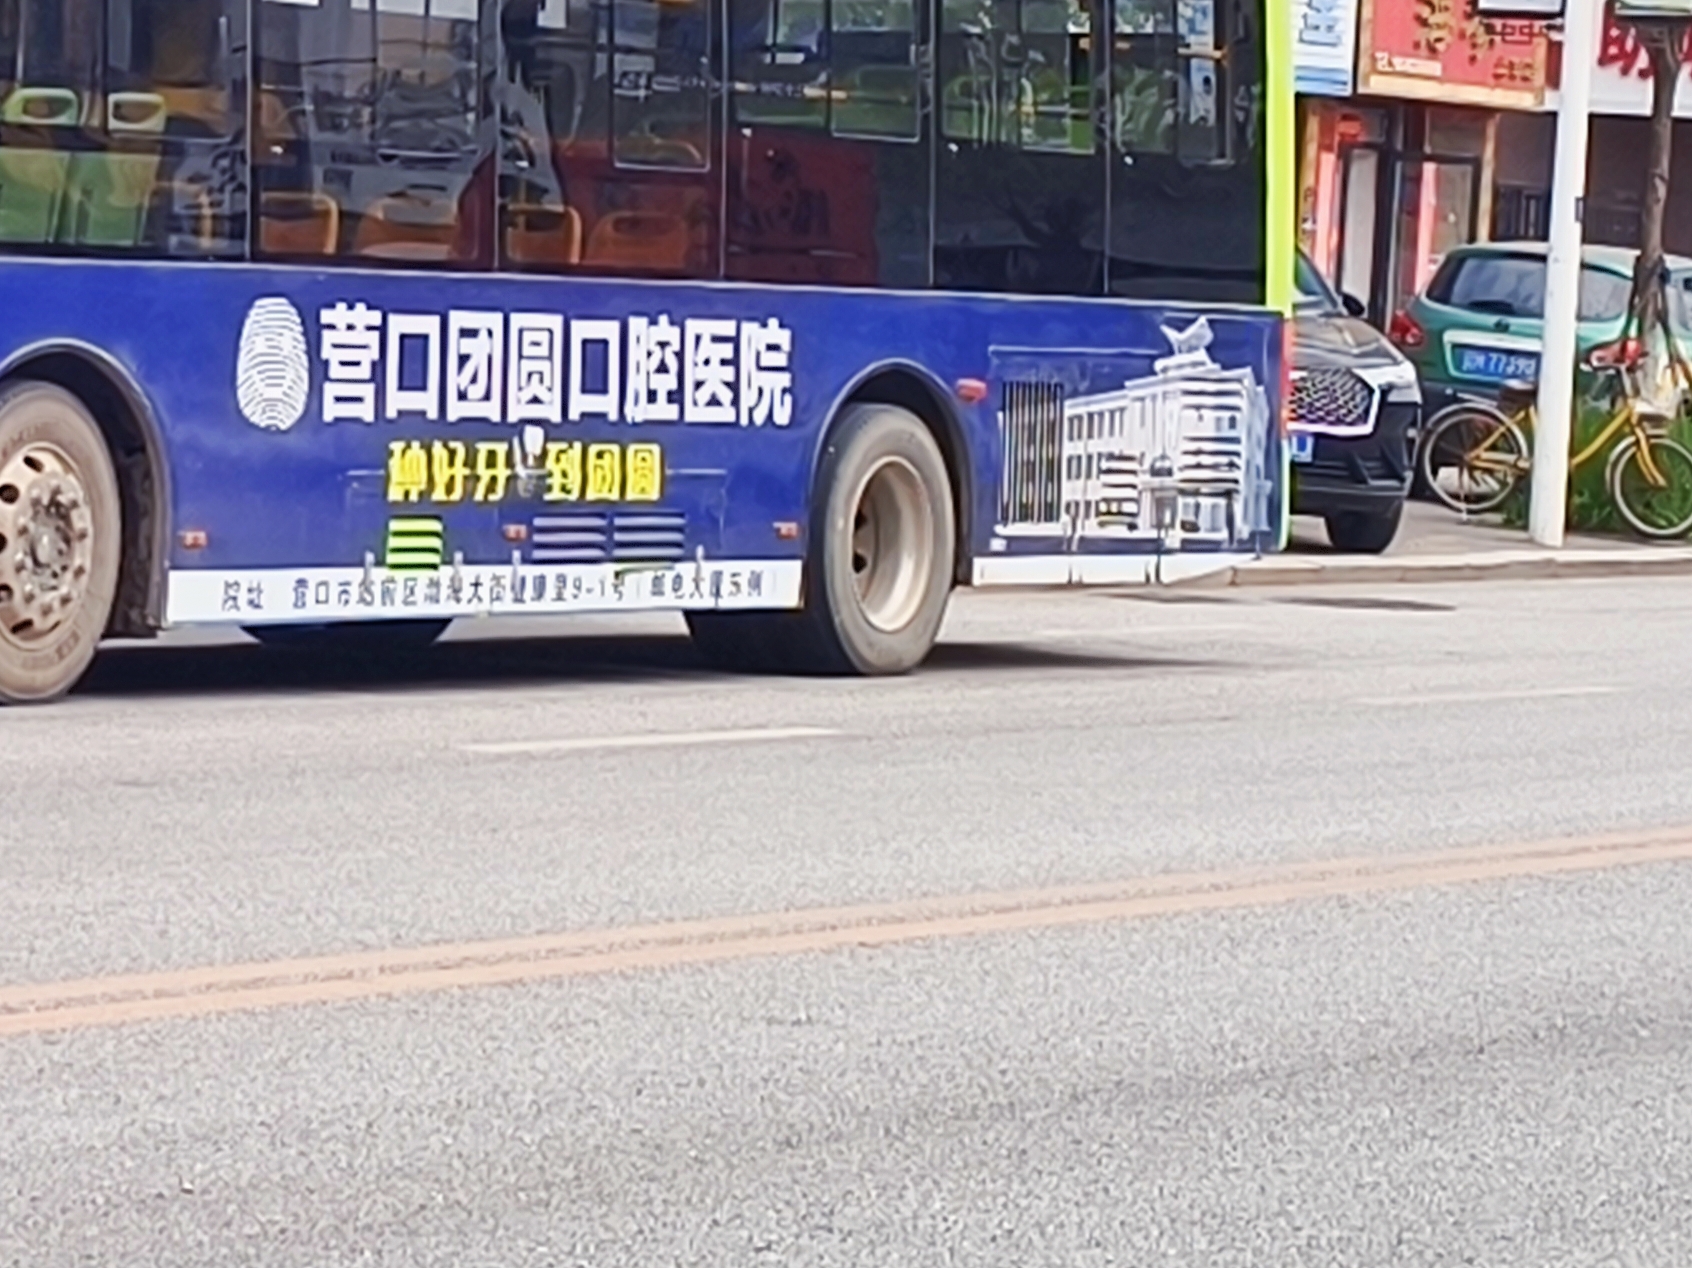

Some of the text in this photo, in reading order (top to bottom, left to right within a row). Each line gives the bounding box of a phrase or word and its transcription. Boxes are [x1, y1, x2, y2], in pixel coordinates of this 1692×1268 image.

[319, 301, 793, 428] 营口团圆口腔医院
[543, 440, 661, 502] 到团圆
